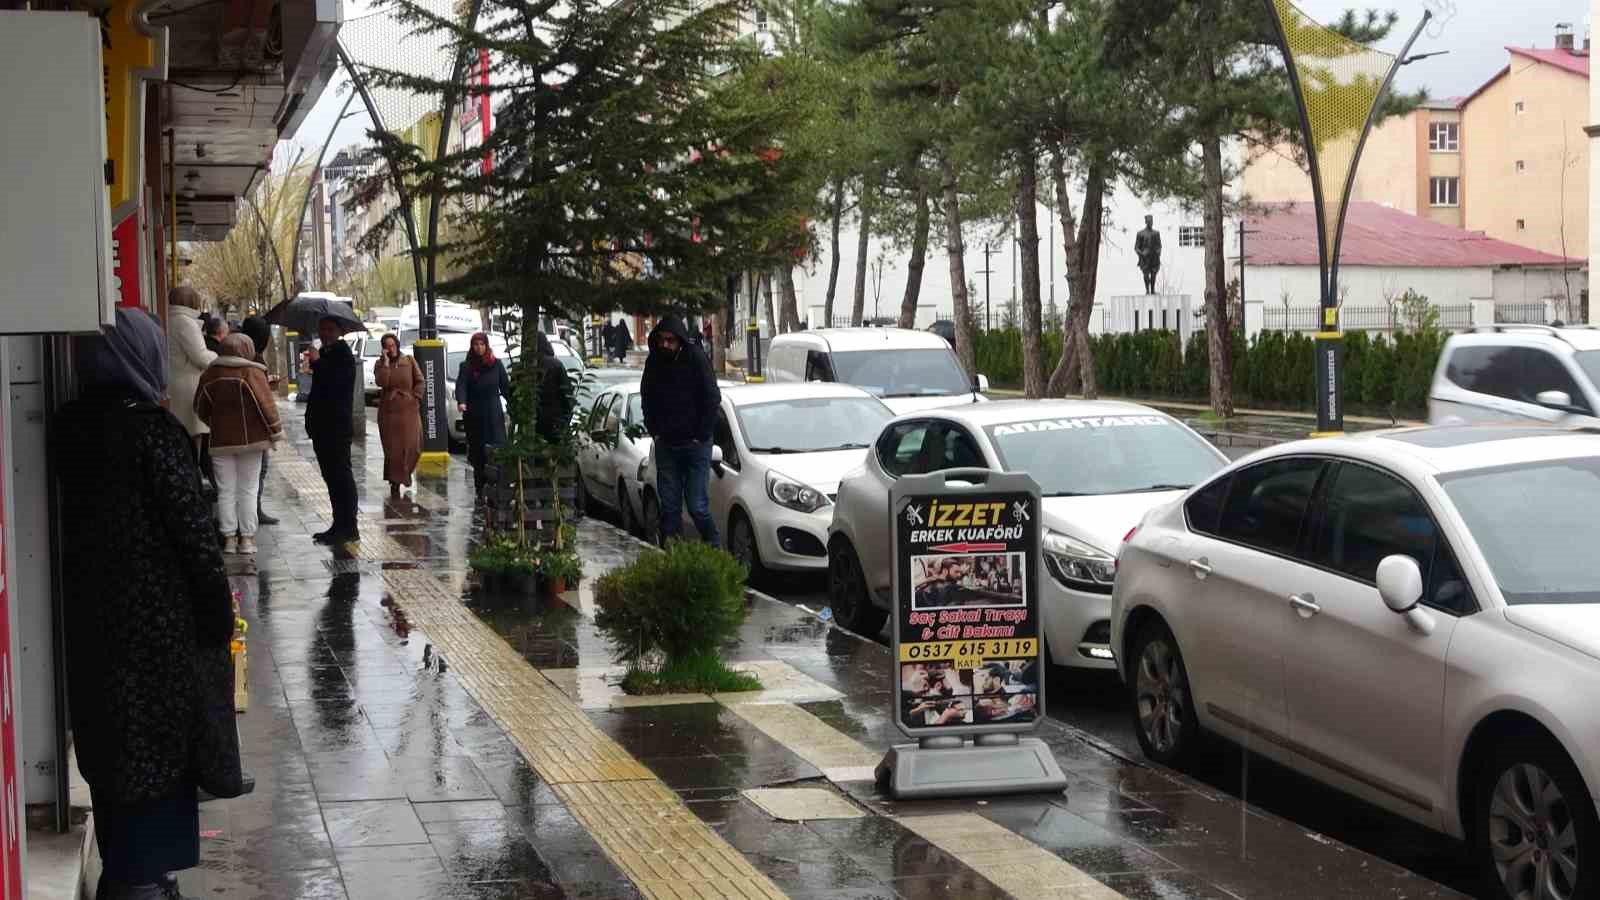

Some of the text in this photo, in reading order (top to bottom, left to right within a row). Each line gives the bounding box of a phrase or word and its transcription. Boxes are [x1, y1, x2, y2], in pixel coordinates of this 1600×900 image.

[928, 499, 1006, 527] İZZET
[910, 525, 1023, 543] ERKEK KUAFÖRÜ
[909, 611, 936, 626] Saç
[939, 609, 982, 623] Sakal
[908, 640, 1032, 658] 0537 615 31 19
